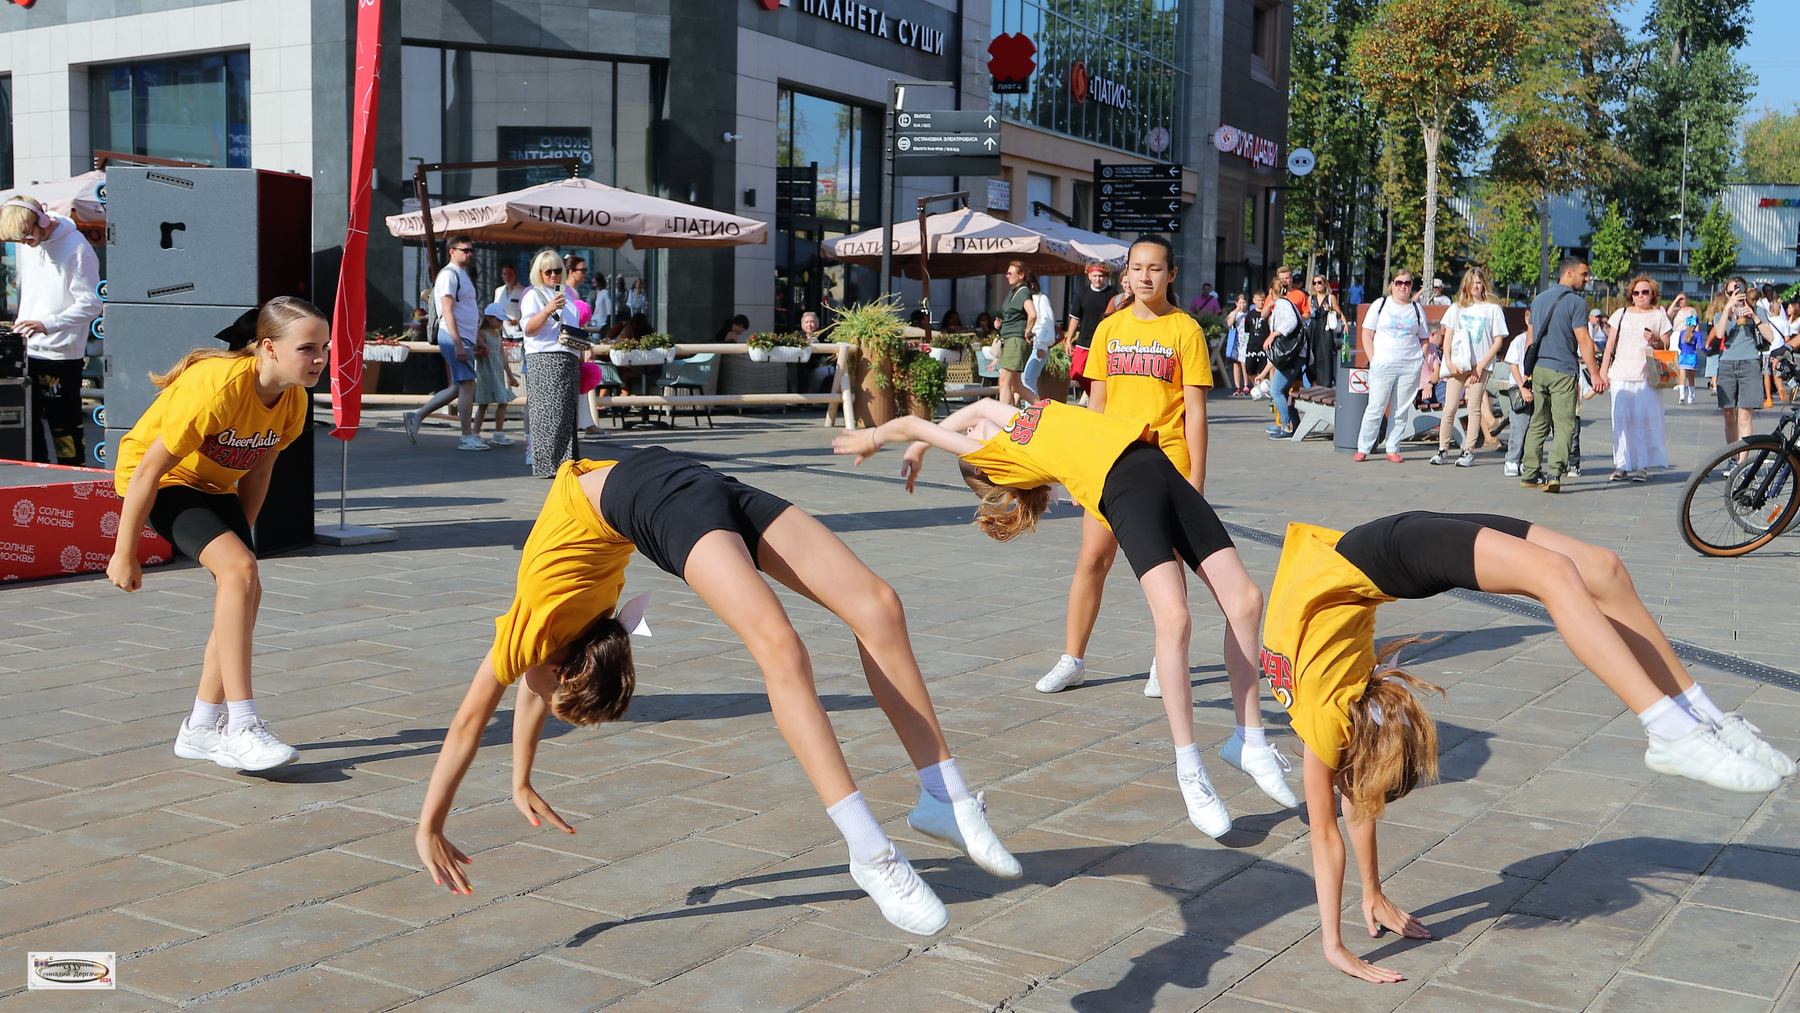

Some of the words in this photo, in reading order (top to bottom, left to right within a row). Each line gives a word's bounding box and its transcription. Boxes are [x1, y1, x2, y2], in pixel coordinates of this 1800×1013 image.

[898, 18, 944, 56] СУШИ
[1094, 75, 1127, 110] ПАТИО
[398, 215, 425, 232] ПАТИ
[539, 205, 611, 226] ПАТИО
[665, 219, 672, 229] iL
[674, 216, 740, 236] ПАТИО
[953, 237, 1013, 251] ПАТИО
[1107, 339, 1174, 358] Cheerleading
[199, 434, 269, 469] SENAT
[95, 488, 119, 499] МОСК
[39, 506, 74, 519] СОЛНЦЕ
[36, 516, 75, 528] МОСКВЫ
[0, 541, 35, 554] СОЛНЦЕ
[83, 561, 108, 571] МОСК
